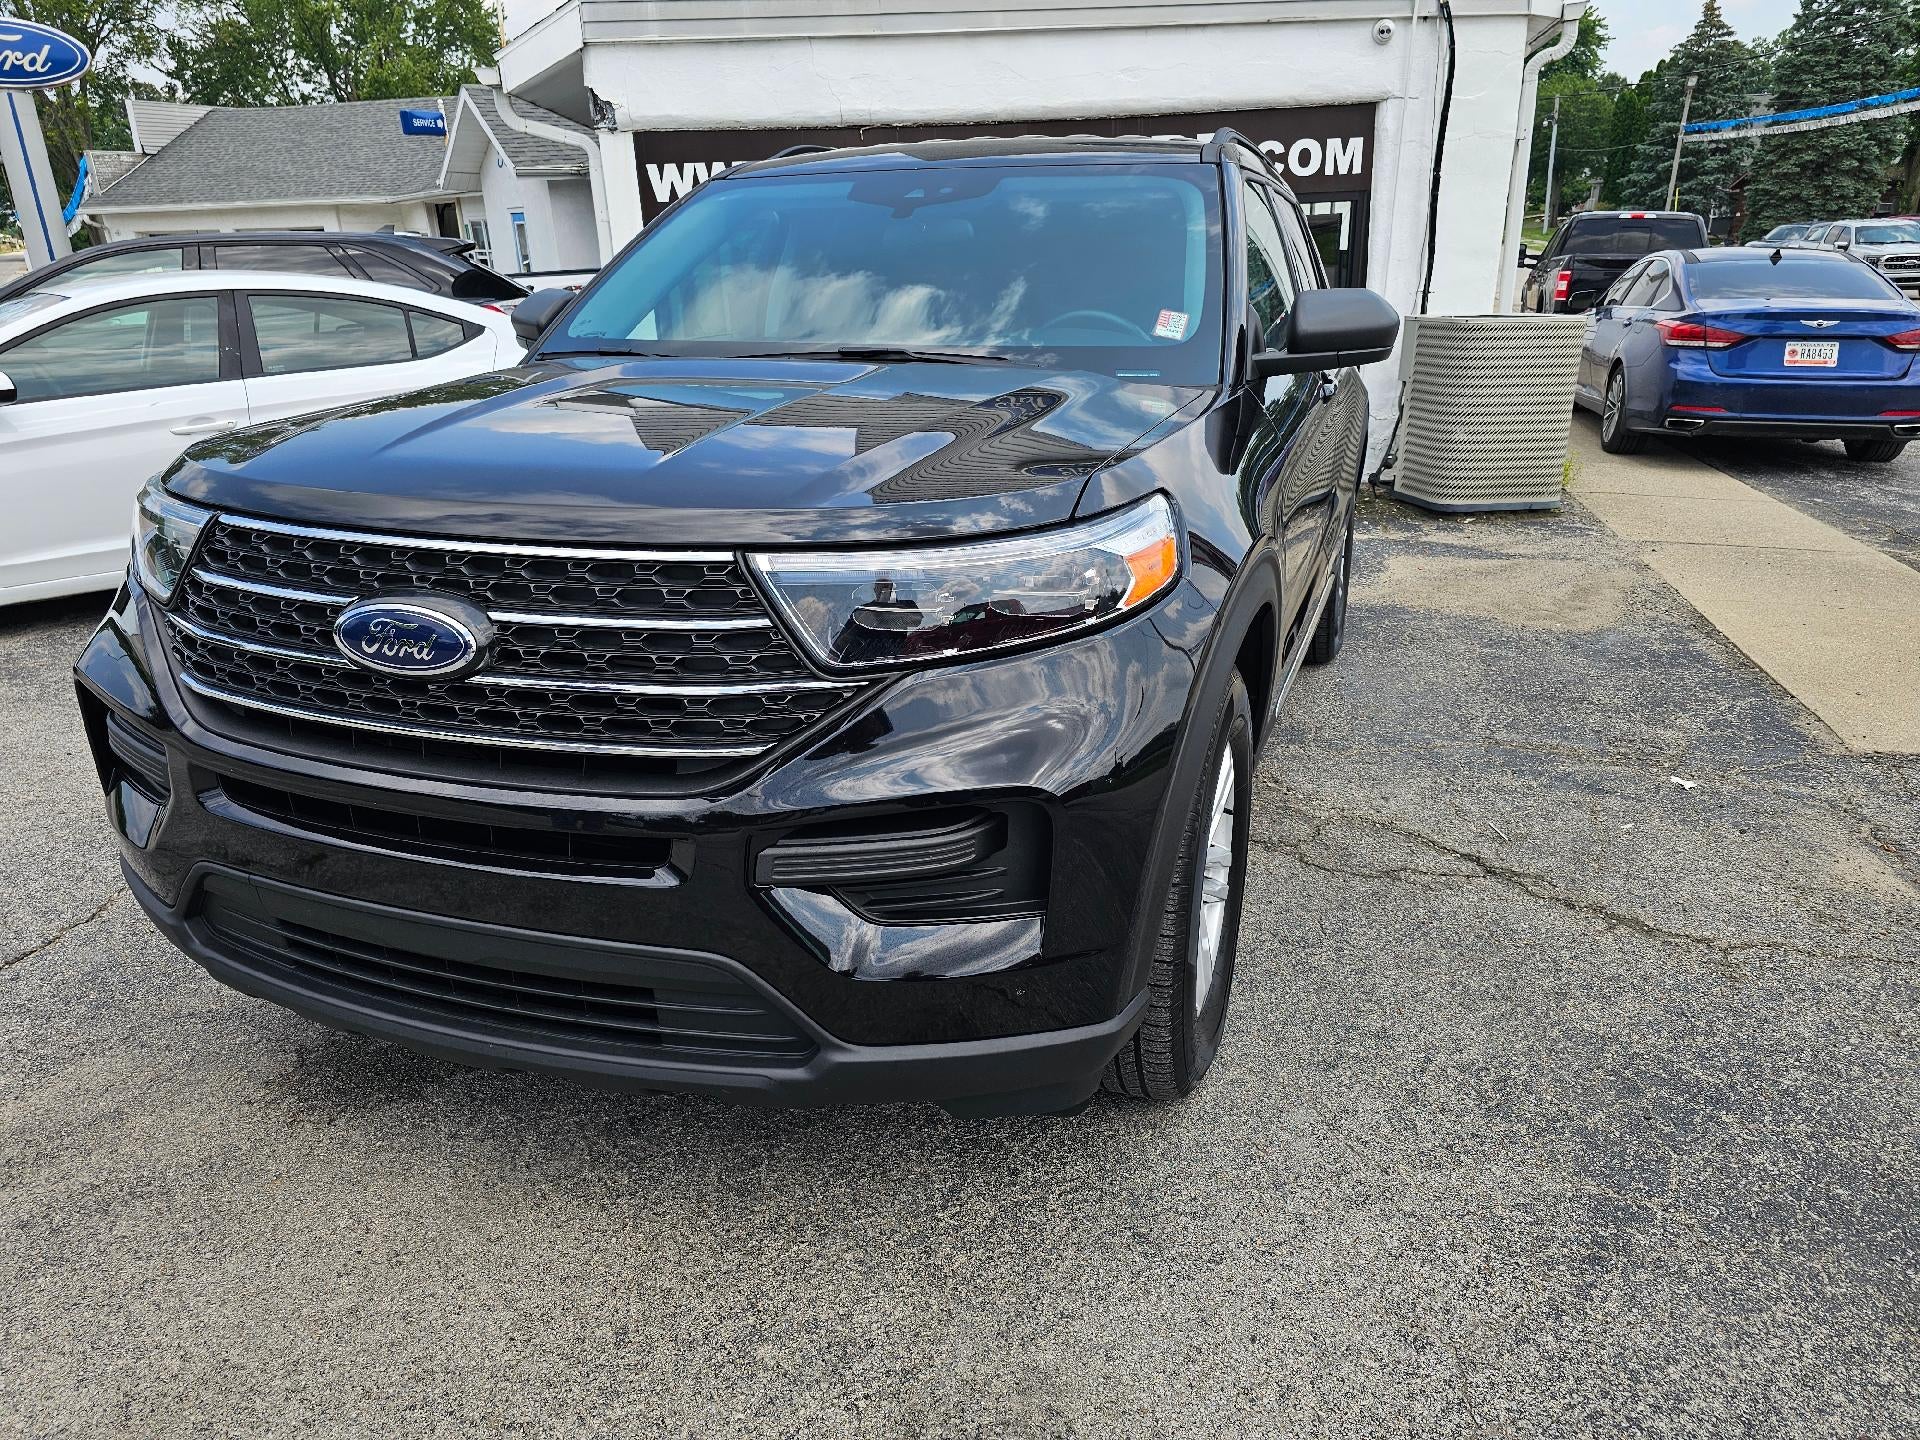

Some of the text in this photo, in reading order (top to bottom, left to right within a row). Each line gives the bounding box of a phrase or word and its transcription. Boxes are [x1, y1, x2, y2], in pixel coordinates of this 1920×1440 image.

[0, 34, 52, 72] rd
[412, 118, 436, 128] SERVICE
[361, 617, 438, 660] Ford
